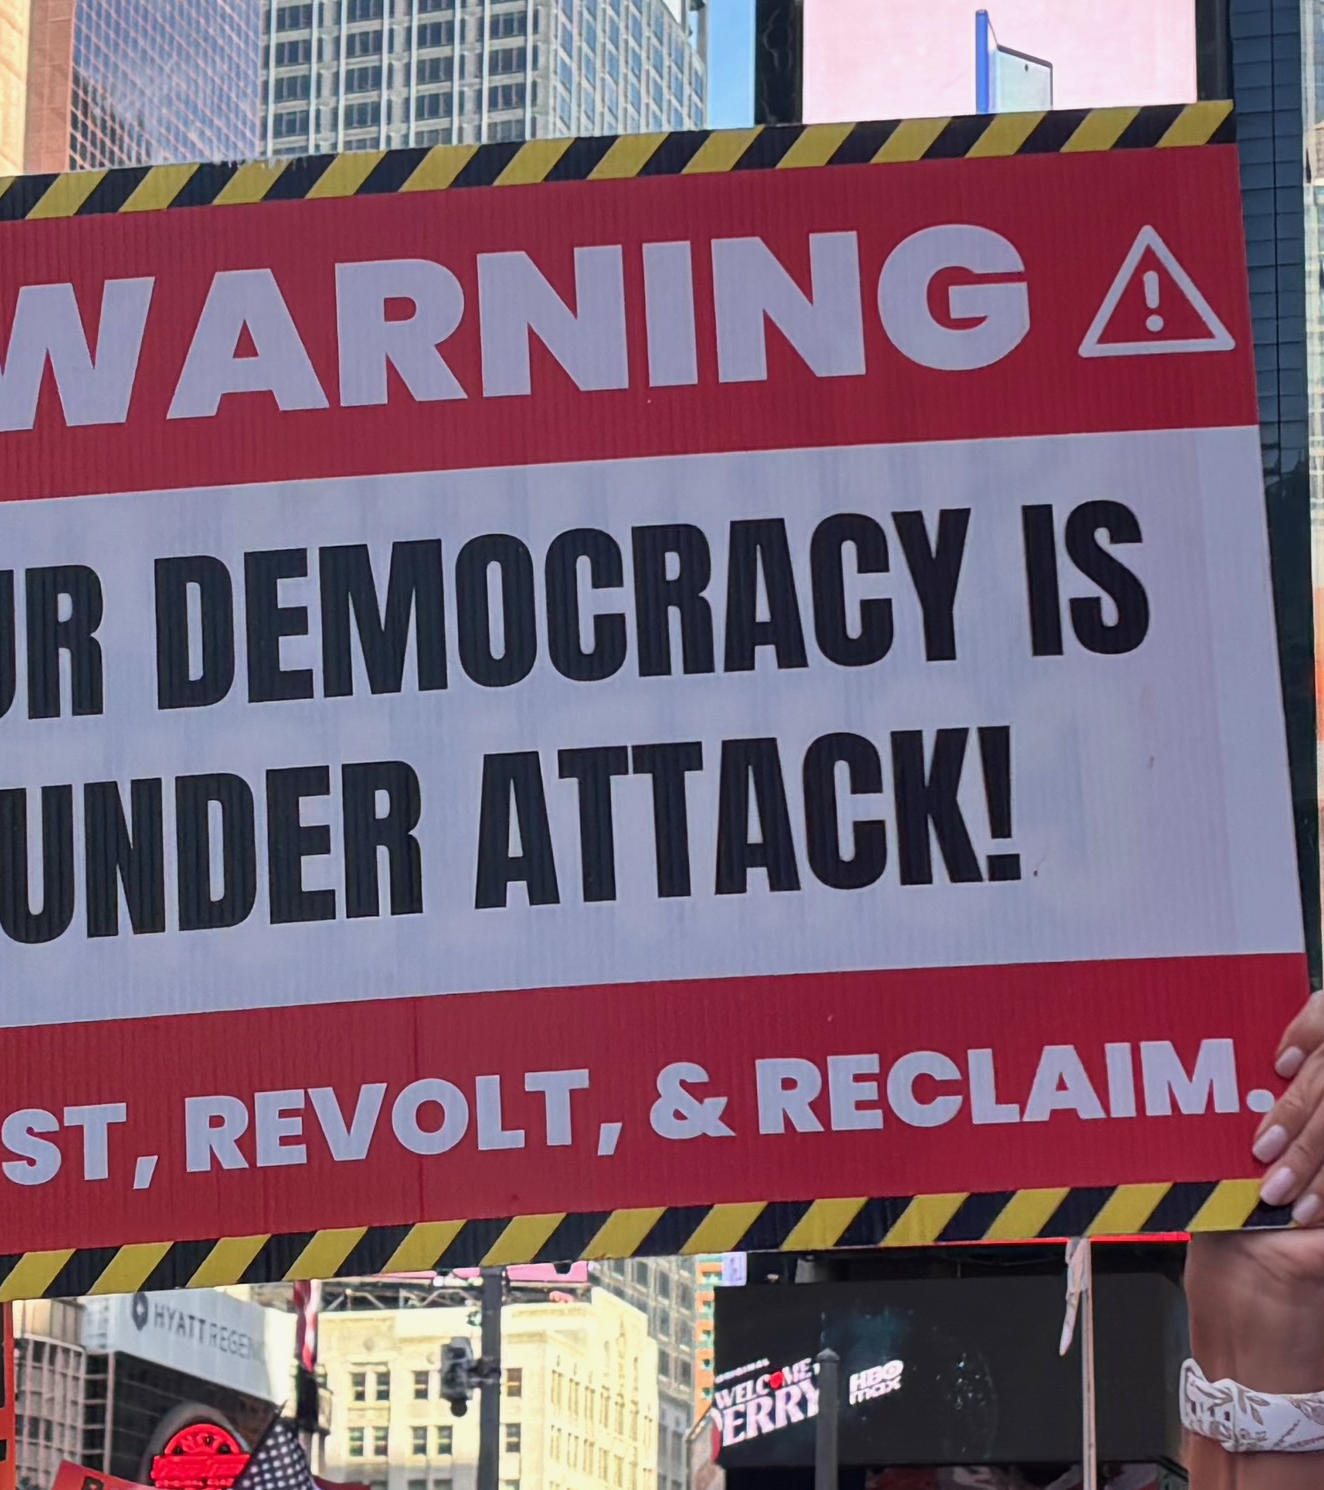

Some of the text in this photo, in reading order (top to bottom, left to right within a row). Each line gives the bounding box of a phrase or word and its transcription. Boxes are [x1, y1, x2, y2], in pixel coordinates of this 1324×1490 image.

[154, 508, 972, 710] DEMOCRACY
[1022, 499, 1151, 657] IS
[475, 725, 1022, 910] ATTACK!
[184, 1067, 623, 1175] REVOLT,
[649, 1061, 736, 1140] &
[755, 1038, 1276, 1136] RECLAIM.
[153, 1302, 207, 1343] HYATT
[714, 1357, 813, 1410] WELCOME
[849, 1359, 905, 1394] HBO
